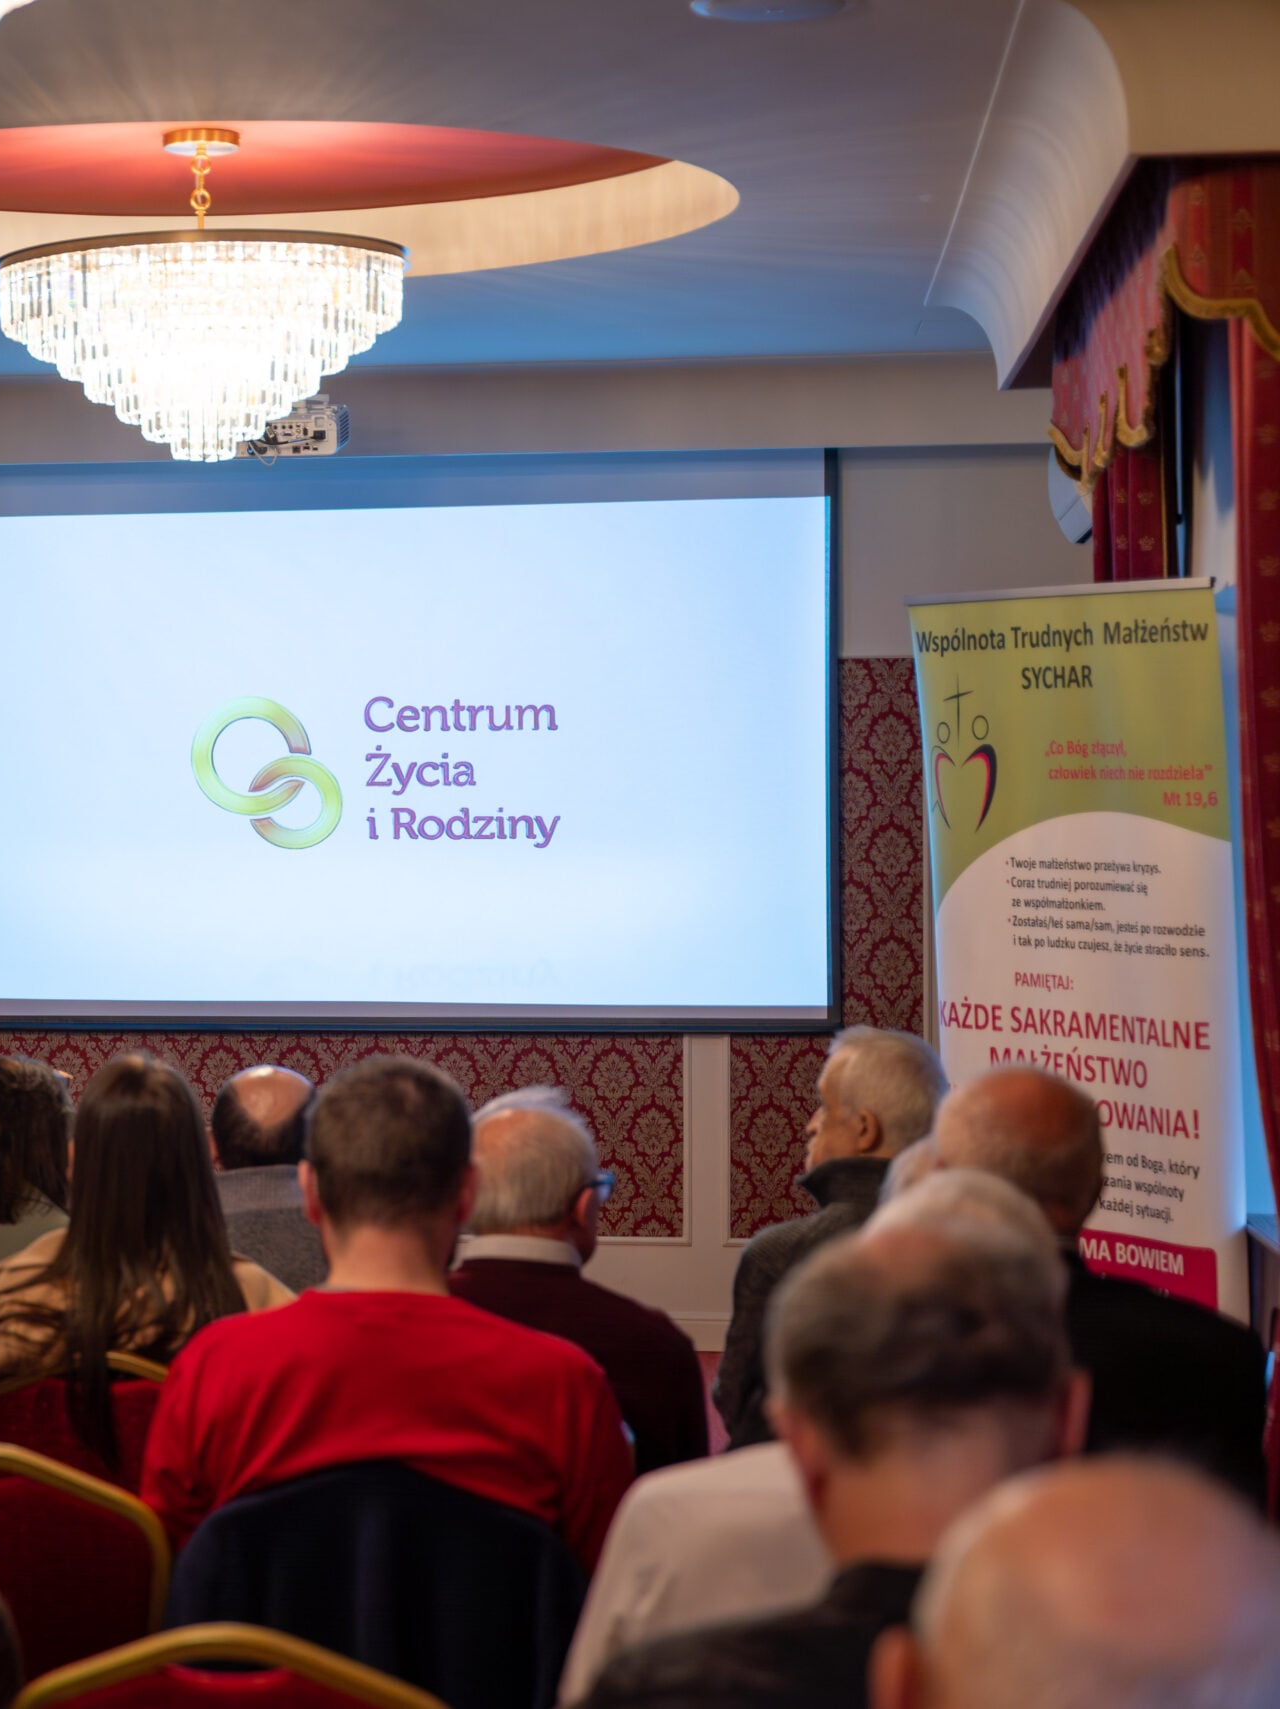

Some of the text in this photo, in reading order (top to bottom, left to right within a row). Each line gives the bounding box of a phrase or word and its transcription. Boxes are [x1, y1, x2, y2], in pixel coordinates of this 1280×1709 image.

[916, 618, 1208, 657] Wspólnota Trudnych Małżeństw
[1021, 665, 1092, 690] SYCHAR
[364, 696, 558, 732] Centrum
[1067, 740, 1088, 758] Bóg
[365, 745, 476, 796] Życia
[1048, 765, 1096, 780] człowiek
[1100, 765, 1125, 780] niech
[1128, 765, 1144, 780] nie
[1163, 791, 1218, 808] Mt 19,6
[367, 807, 560, 848] i Rodziny
[1010, 857, 1162, 875] Twoje małżeństwo przeżywa kryzys.
[1011, 877, 1148, 896] Coraz trudniej porozumiewać się
[1012, 898, 1020, 907] ze
[1066, 918, 1114, 932] sama/sam,
[1116, 920, 1138, 934] jesteś
[1140, 925, 1150, 936] po
[1153, 924, 1206, 936] rozwodzie
[1018, 935, 1032, 946] tak
[1034, 938, 1045, 949] po
[1048, 936, 1076, 949] ludzku
[1078, 938, 1112, 952] czujesz,
[1114, 940, 1122, 952] że
[1124, 941, 1142, 955] życie
[1144, 944, 1176, 956] straciło
[1180, 948, 1210, 958] sens.
[1015, 972, 1074, 992] PAMIĘTAJ:
[940, 996, 1210, 1050] KAŻDE SAKRAMENTALNE
[1096, 1100, 1200, 1139] OWANIA!
[1127, 1154, 1139, 1166] od
[1142, 1156, 1166, 1174] Boga,
[1170, 1159, 1200, 1180] który
[1103, 1176, 1184, 1202] zania wspólnoty
[1100, 1198, 1174, 1224] każdej sytuacji.
[1116, 1242, 1184, 1276] BOWIEM
